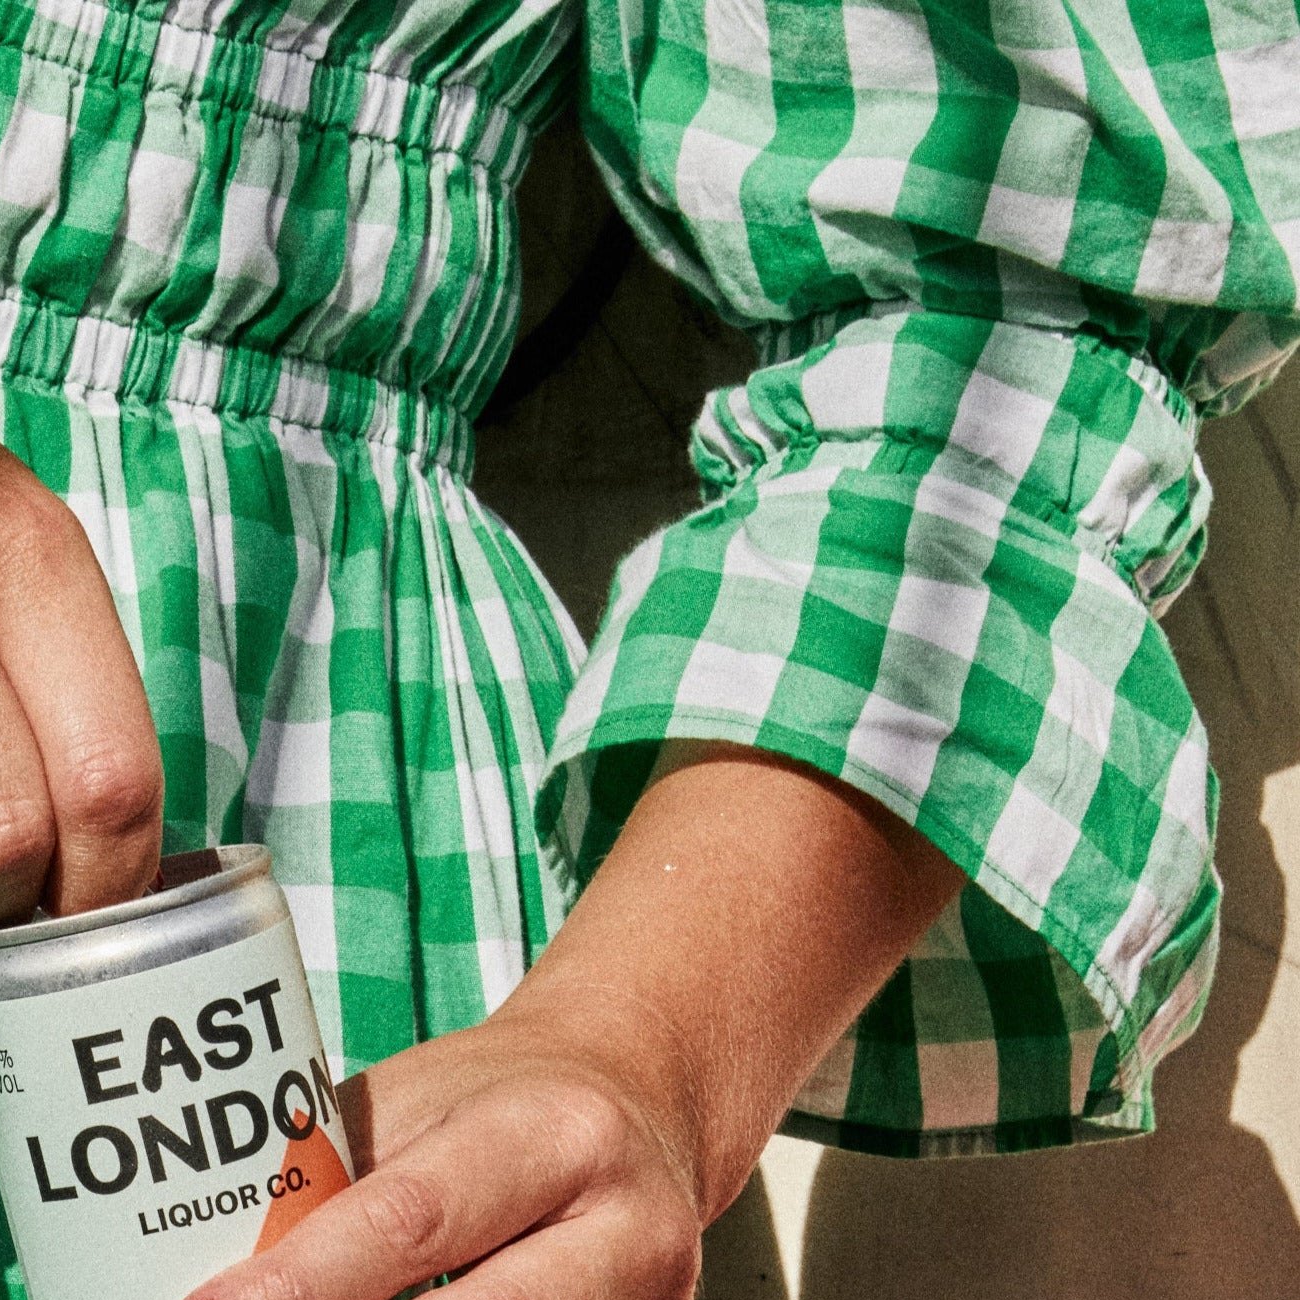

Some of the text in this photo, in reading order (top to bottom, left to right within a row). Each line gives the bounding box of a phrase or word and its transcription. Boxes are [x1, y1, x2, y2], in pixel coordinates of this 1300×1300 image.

[72, 977, 284, 1105] EAST
[26, 1048, 339, 1203] LONDON
[138, 1165, 311, 1236] LIQUOR CO.
